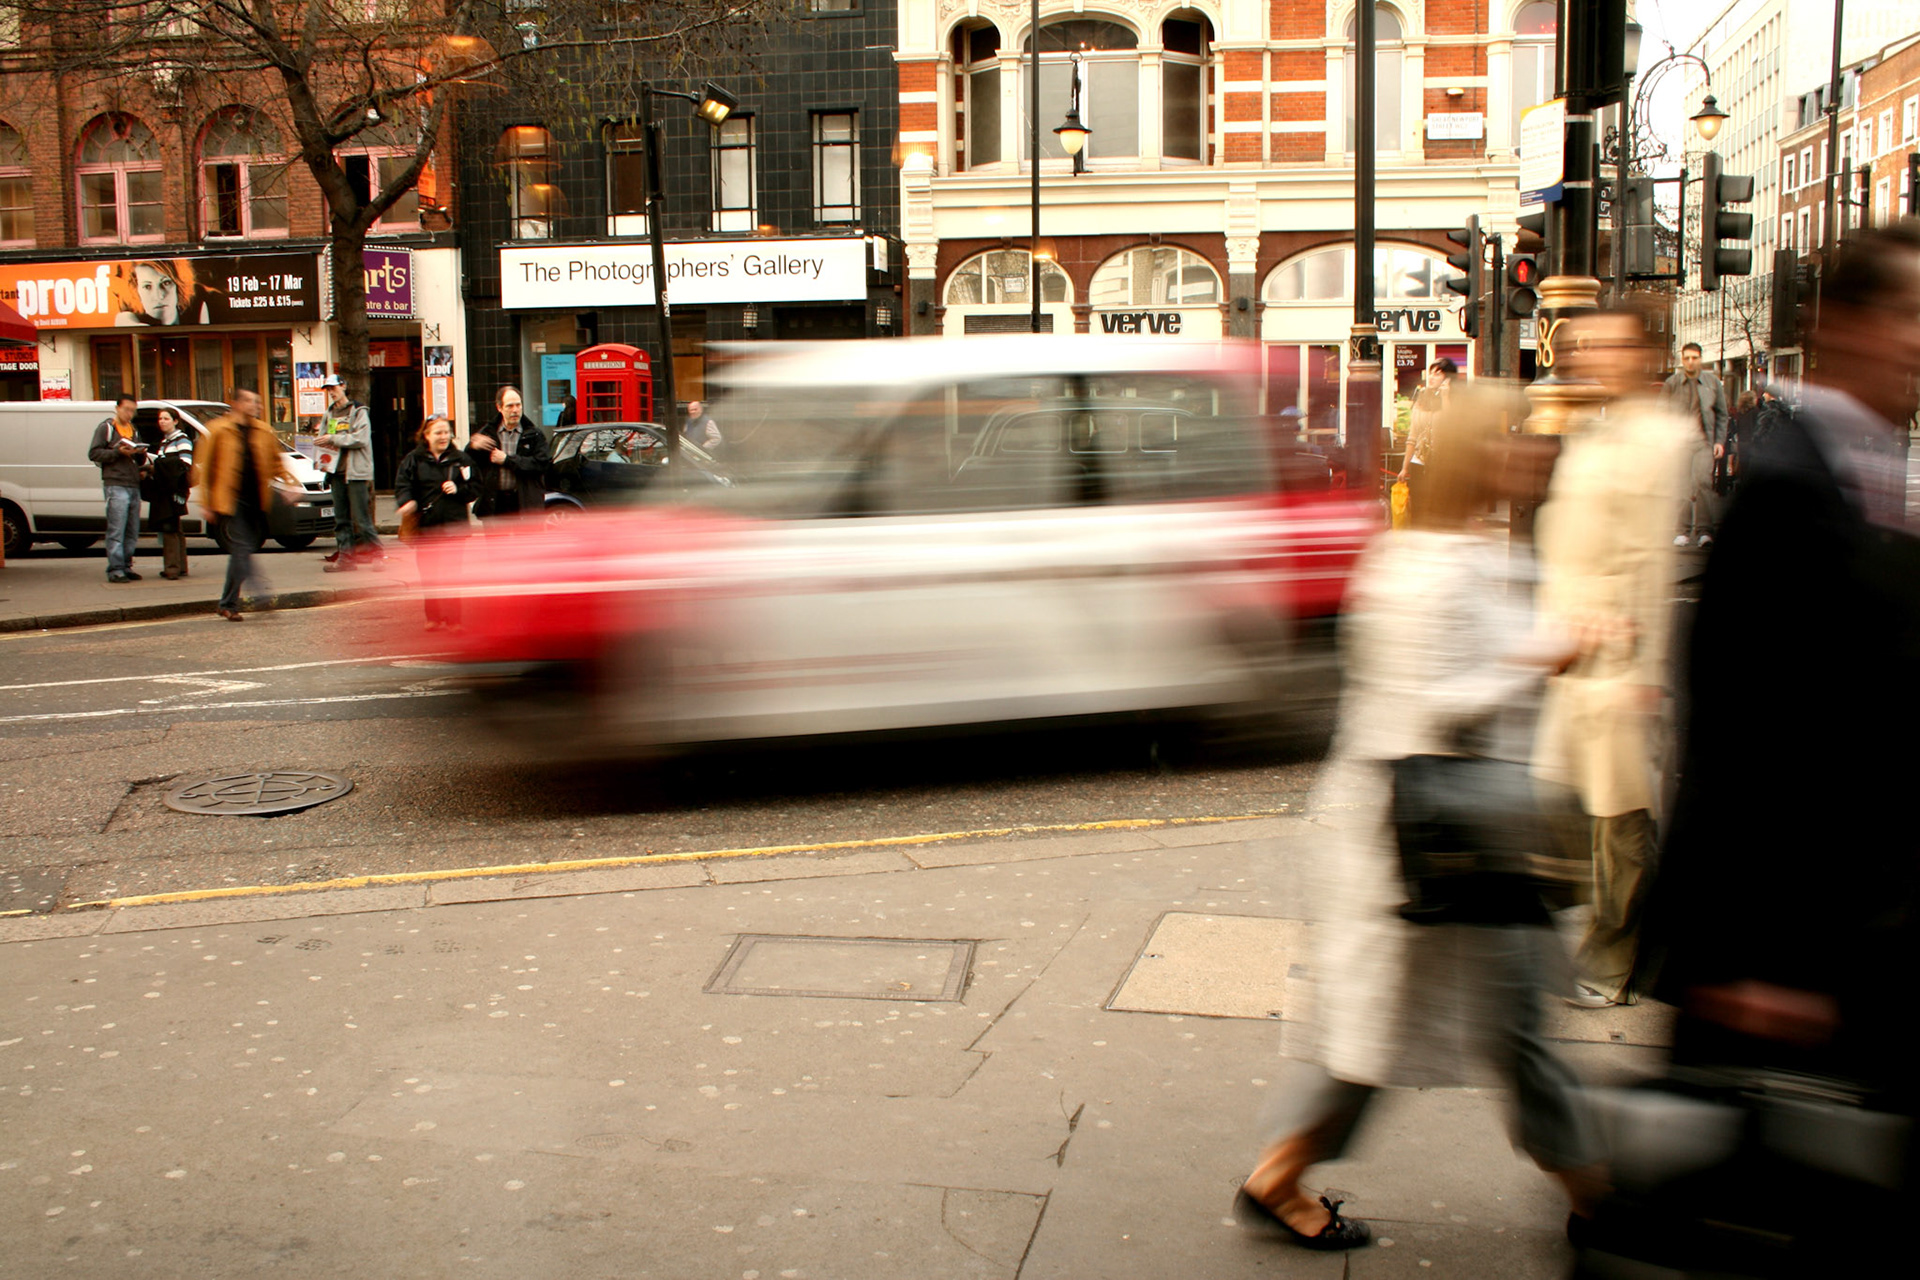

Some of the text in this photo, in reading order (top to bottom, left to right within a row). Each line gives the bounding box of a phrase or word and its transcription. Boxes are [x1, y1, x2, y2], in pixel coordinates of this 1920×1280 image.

[519, 254, 824, 285] The Photogrphers' Gallery
[227, 276, 240, 292] 19
[242, 276, 259, 292] Feb
[269, 275, 281, 291] 17
[284, 274, 303, 290] Mar
[17, 265, 111, 320] proof
[229, 297, 252, 308] Tickets
[253, 296, 268, 307] £25
[269, 296, 275, 307] &
[276, 295, 291, 307] £15
[384, 301, 391, 310] &
[393, 301, 409, 310] bar
[1099, 310, 1182, 335] verve
[1374, 309, 1441, 333] erve
[4, 352, 35, 361] STUDIOS
[19, 362, 39, 370] DOOR
[427, 361, 451, 377] proof
